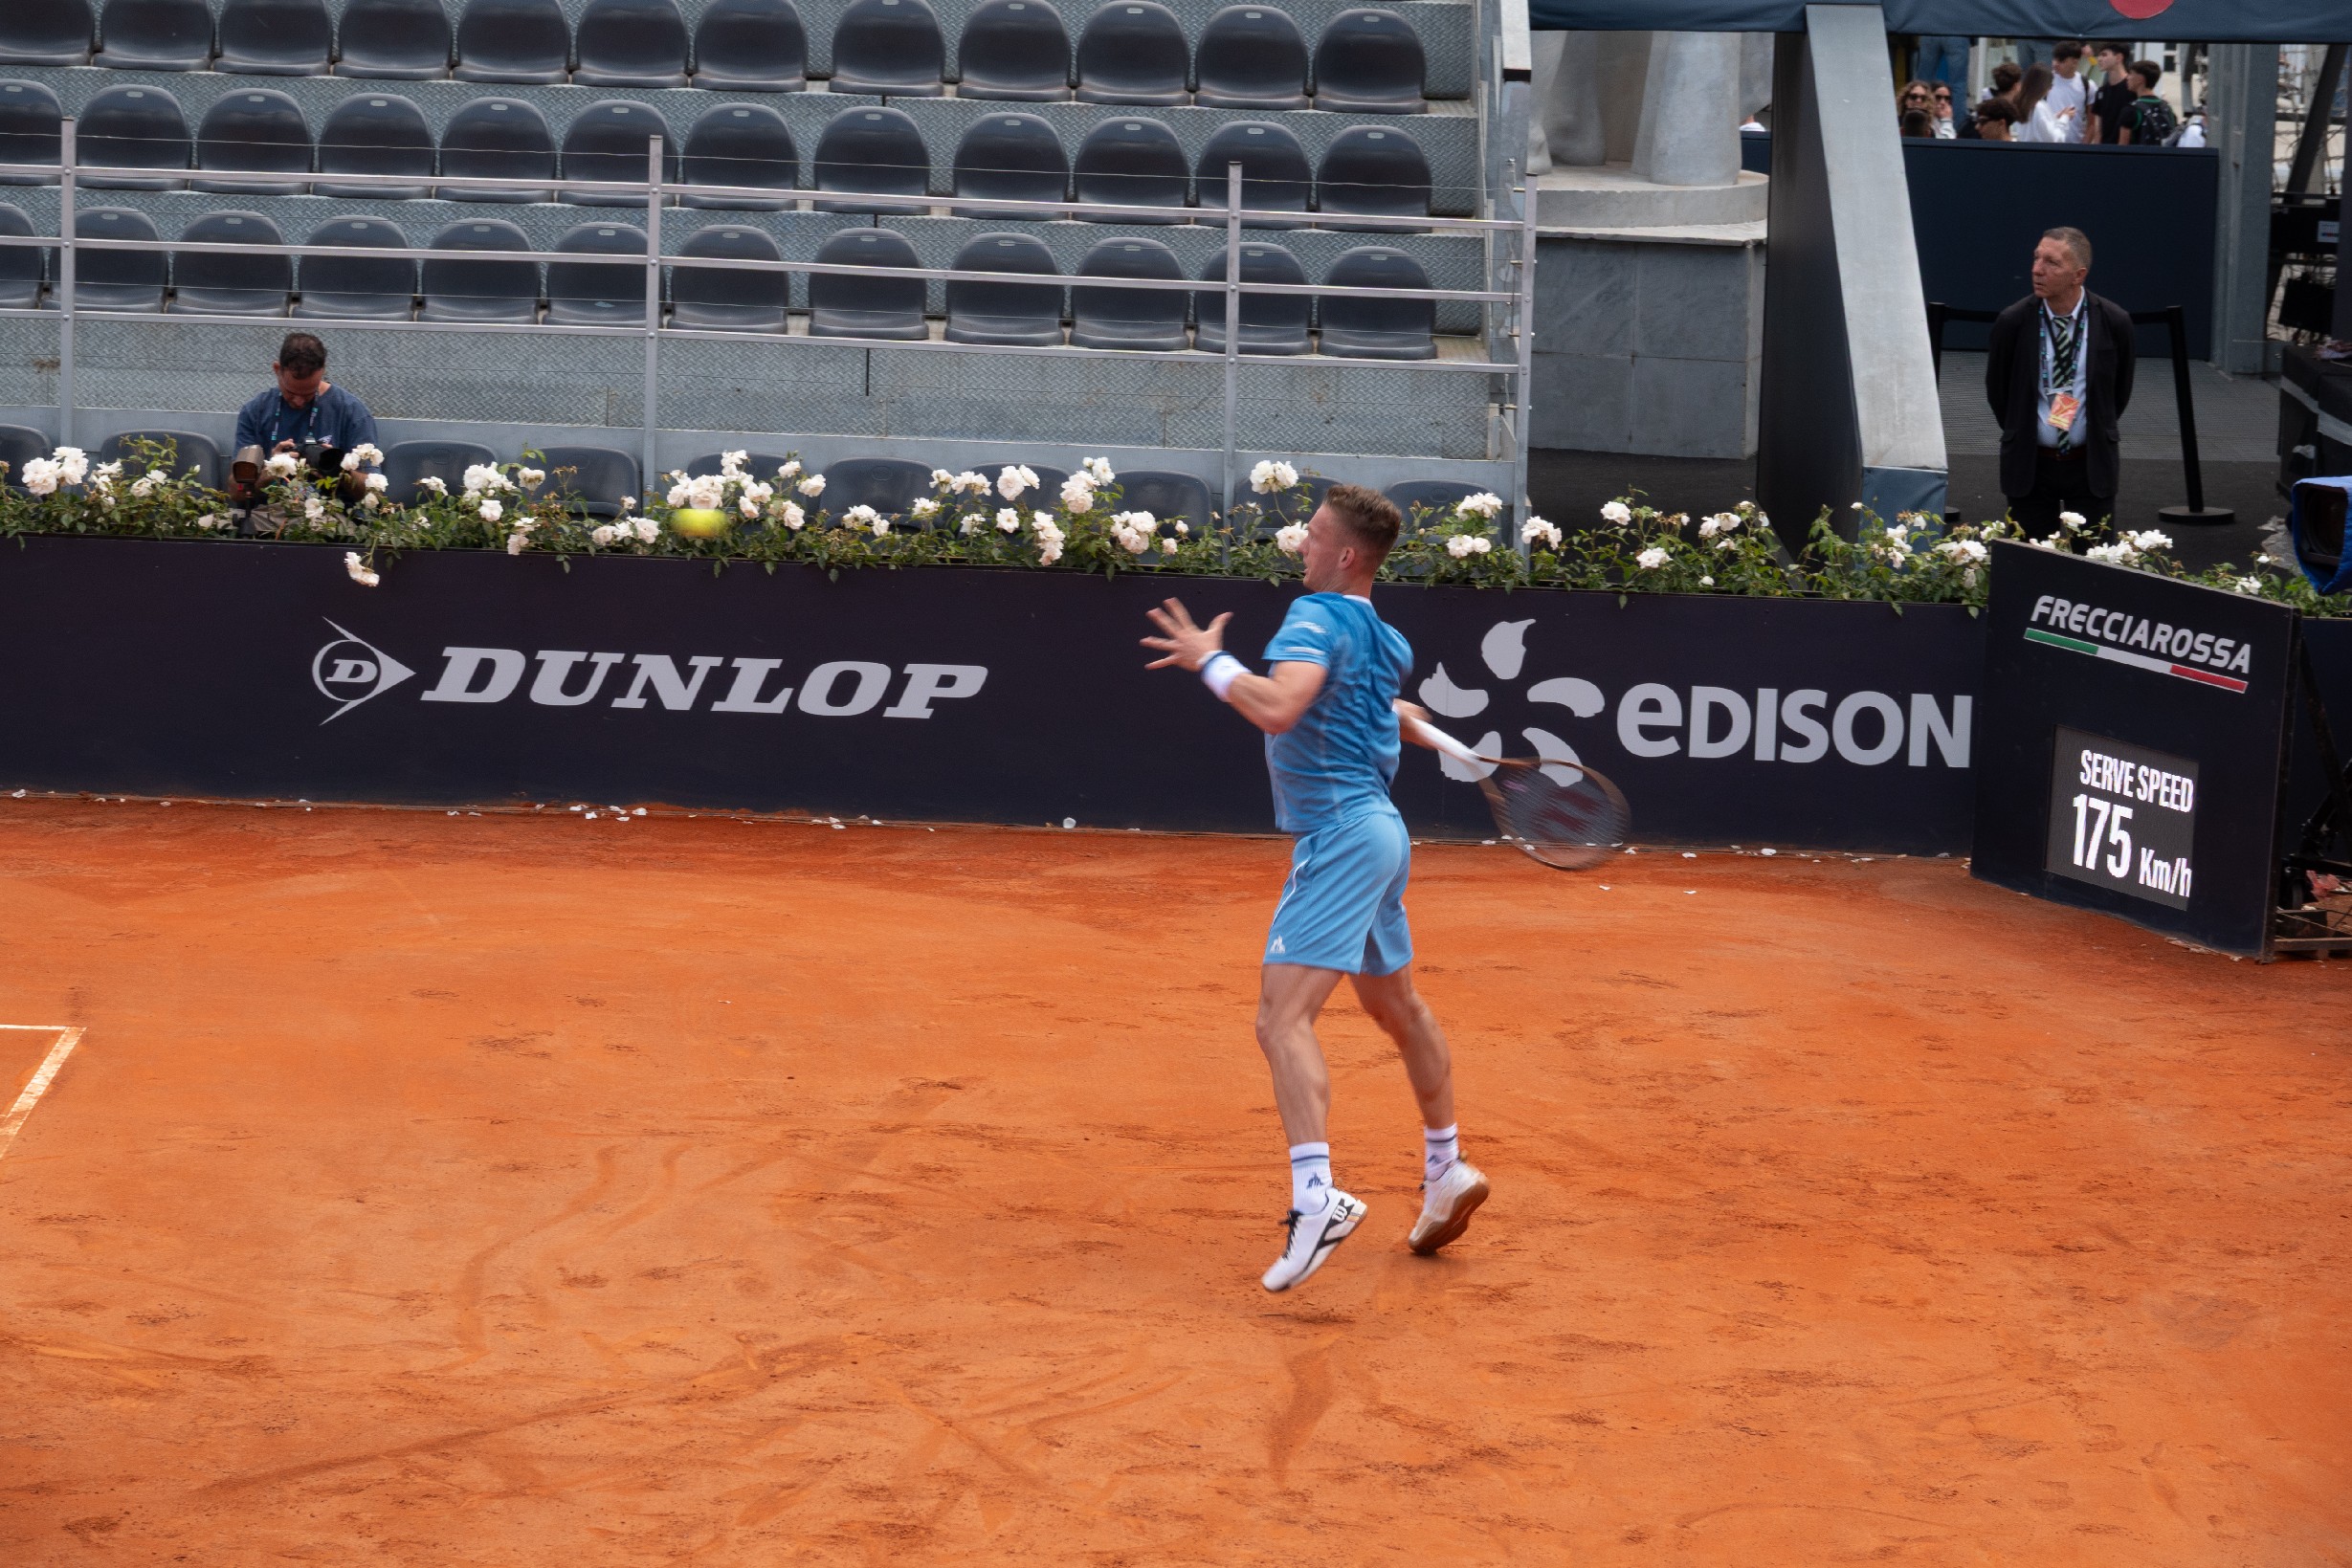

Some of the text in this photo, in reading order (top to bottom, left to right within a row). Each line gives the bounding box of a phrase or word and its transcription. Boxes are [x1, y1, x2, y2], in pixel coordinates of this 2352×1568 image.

[2030, 595, 2251, 674] FRECCIAROSSA
[420, 647, 988, 719] DUNLOP
[2079, 749, 2194, 813] SERVE SPEED
[2073, 793, 2192, 898] 175 Km/h
